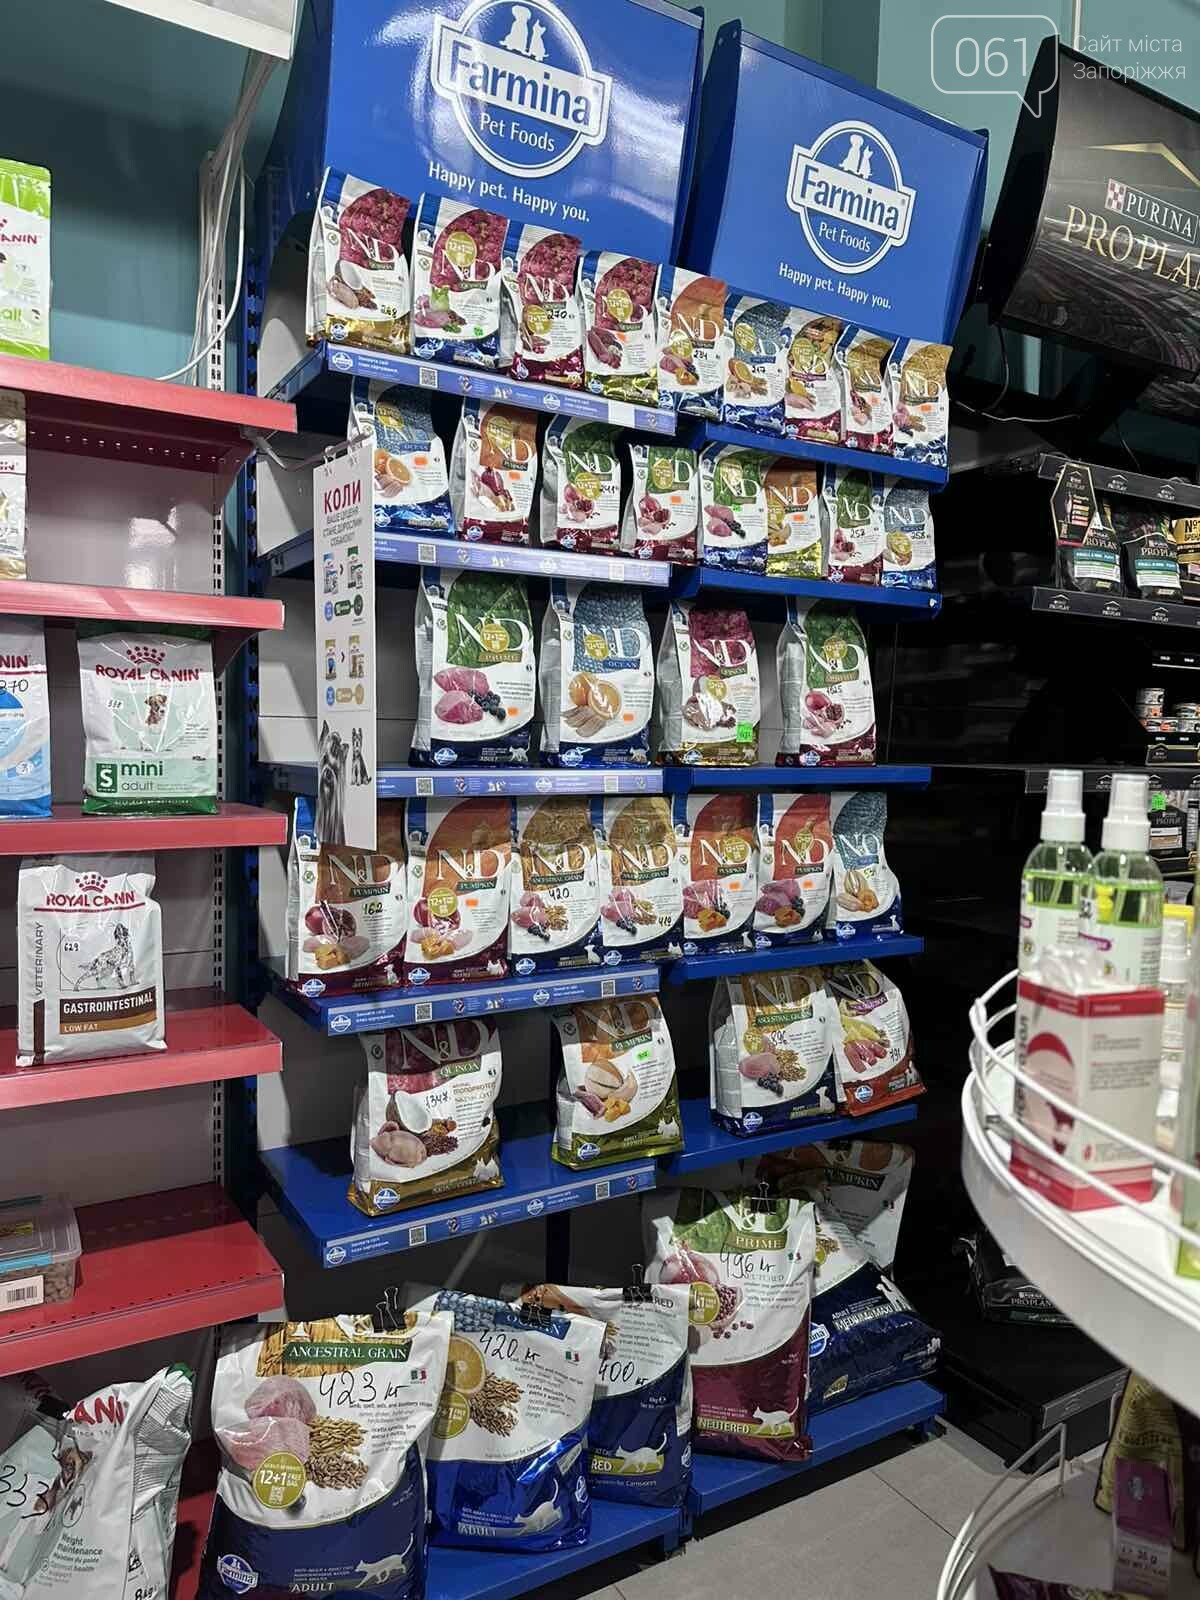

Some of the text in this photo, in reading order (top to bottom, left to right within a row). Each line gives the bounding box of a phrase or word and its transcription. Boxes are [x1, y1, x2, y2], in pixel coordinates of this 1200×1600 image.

[448, 38, 591, 127] Farmina
[480, 113, 556, 152] Pet Foods
[429, 161, 590, 222] Happy pet. Happy you.
[800, 164, 900, 231] Farmina
[1125, 191, 1194, 239] PURINA
[819, 222, 871, 253] Pet Foods
[779, 262, 891, 309] Happy pet. Happy you.
[323, 480, 362, 514] КОЛИ
[95, 664, 200, 682] ROYAL CANIN
[121, 761, 163, 777] mini
[121, 782, 154, 791] adult
[437, 848, 505, 881] N&D
[46, 891, 135, 907] ROYAL CANIN
[549, 886, 570, 901] 420
[35, 921, 46, 996] VETERINARY
[63, 992, 153, 1015] GASTROINTESTINAL
[64, 1023, 98, 1033] LOW FAT
[440, 1063, 480, 1075] QUINOA
[736, 1236, 781, 1249] PRIME
[289, 1345, 407, 1360] ANCESTRAL GRAIN
[479, 1330, 519, 1360] 420
[598, 1360, 635, 1382] 400
[319, 1370, 377, 1409] 423
[698, 1417, 750, 1434] NEUTERED
[259, 1469, 287, 1485] 12+1
[291, 1582, 335, 1593] ADULT
